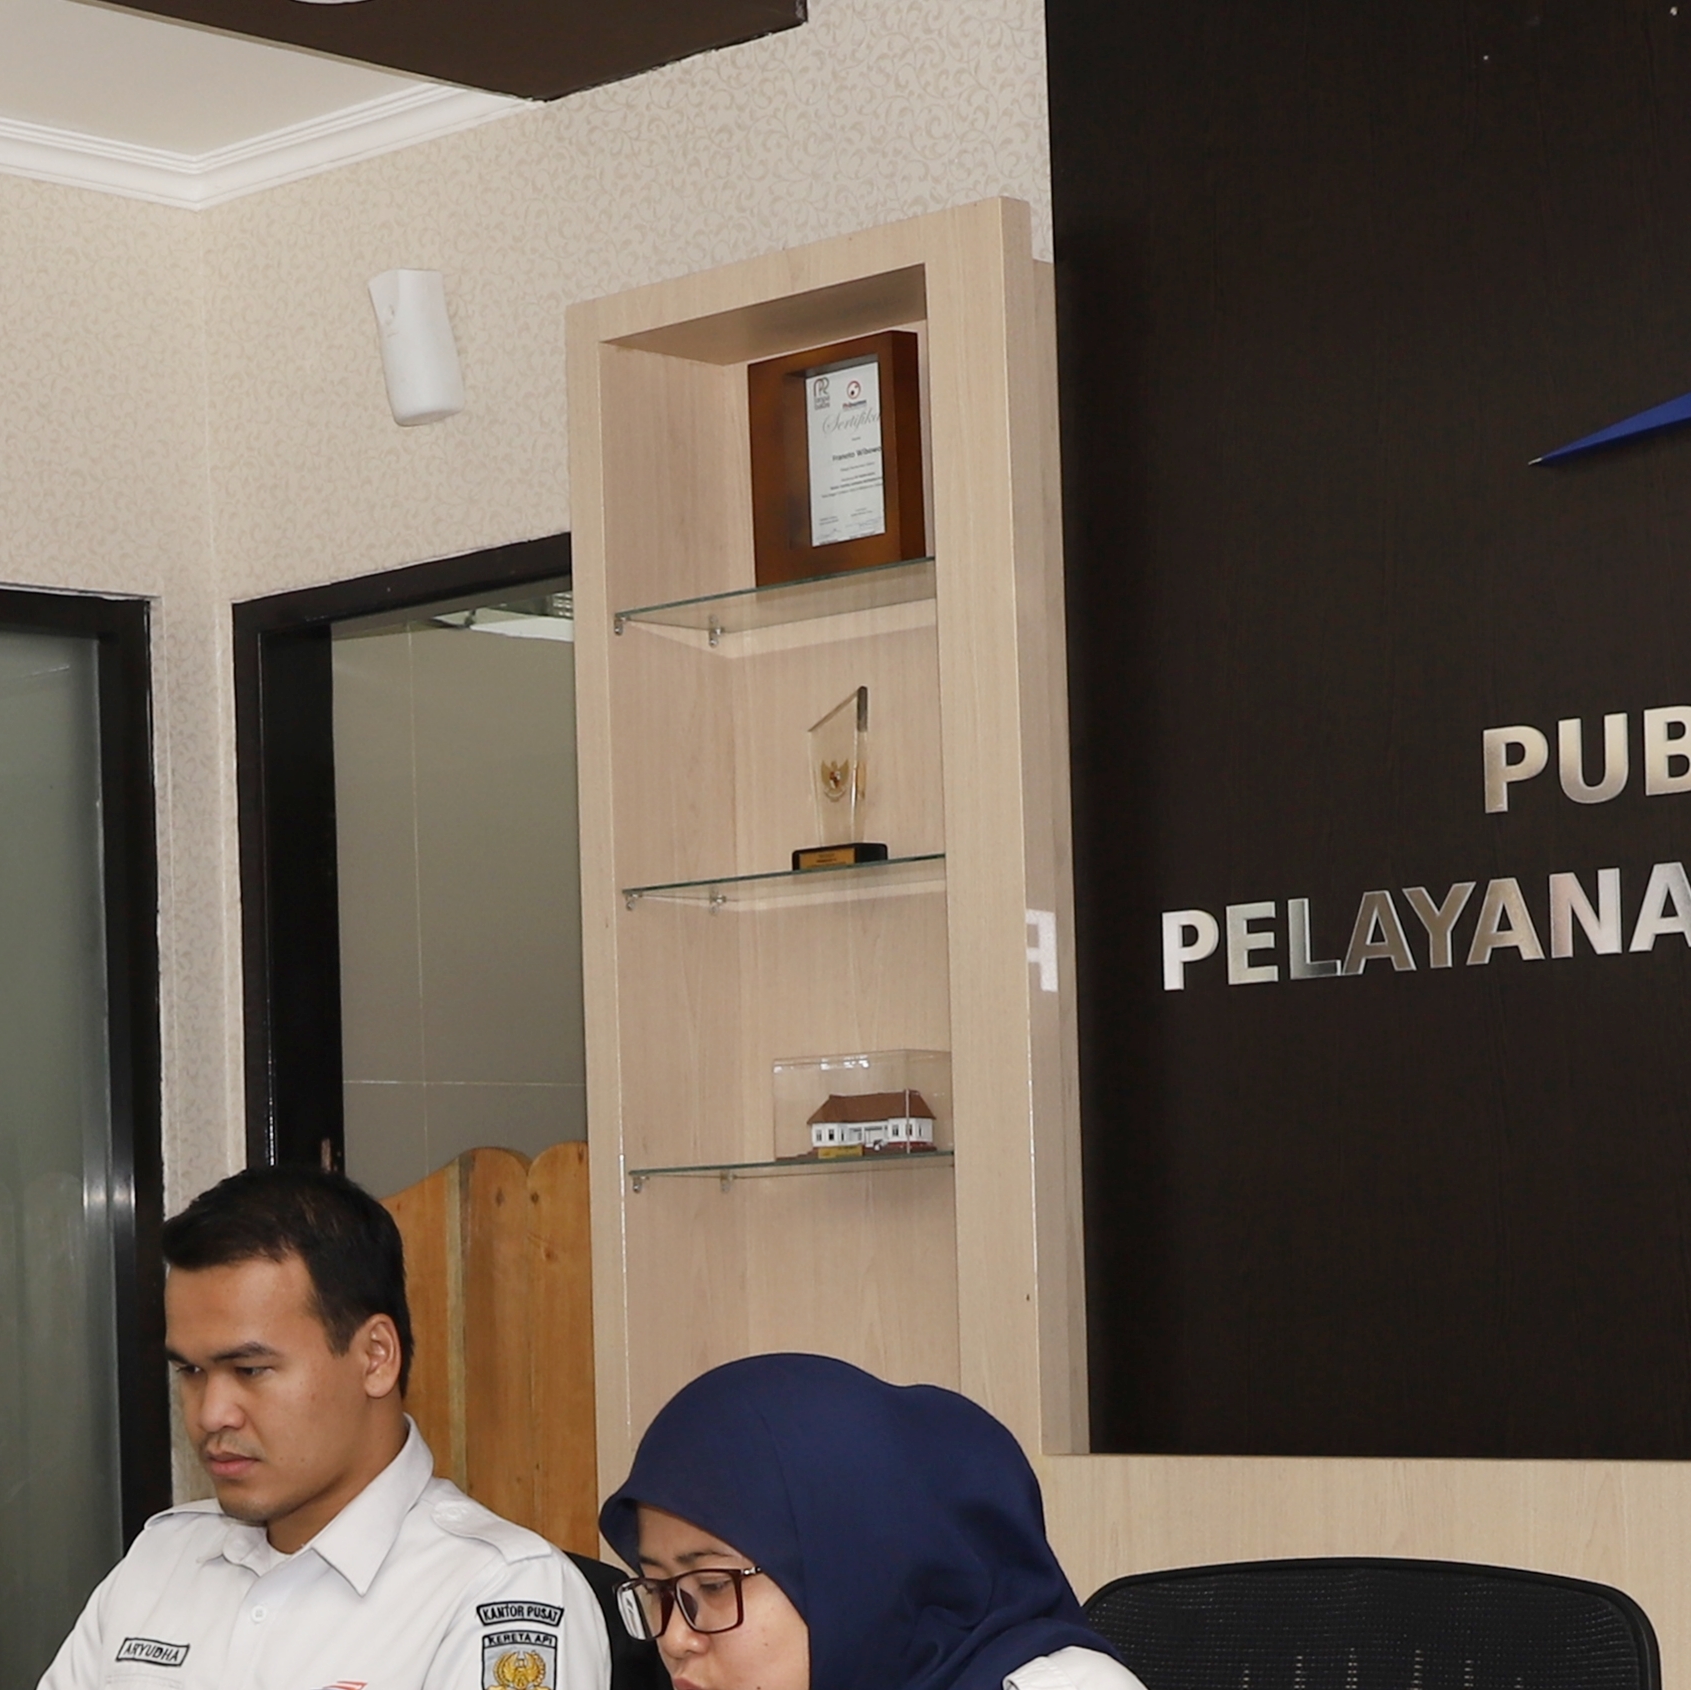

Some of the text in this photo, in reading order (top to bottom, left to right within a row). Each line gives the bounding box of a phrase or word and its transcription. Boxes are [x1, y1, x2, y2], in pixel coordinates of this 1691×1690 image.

[483, 1605, 558, 1622] KANTOR PUSAT
[488, 1633, 552, 1645] KERETA API
[123, 1643, 179, 1661] ARYUDHA
